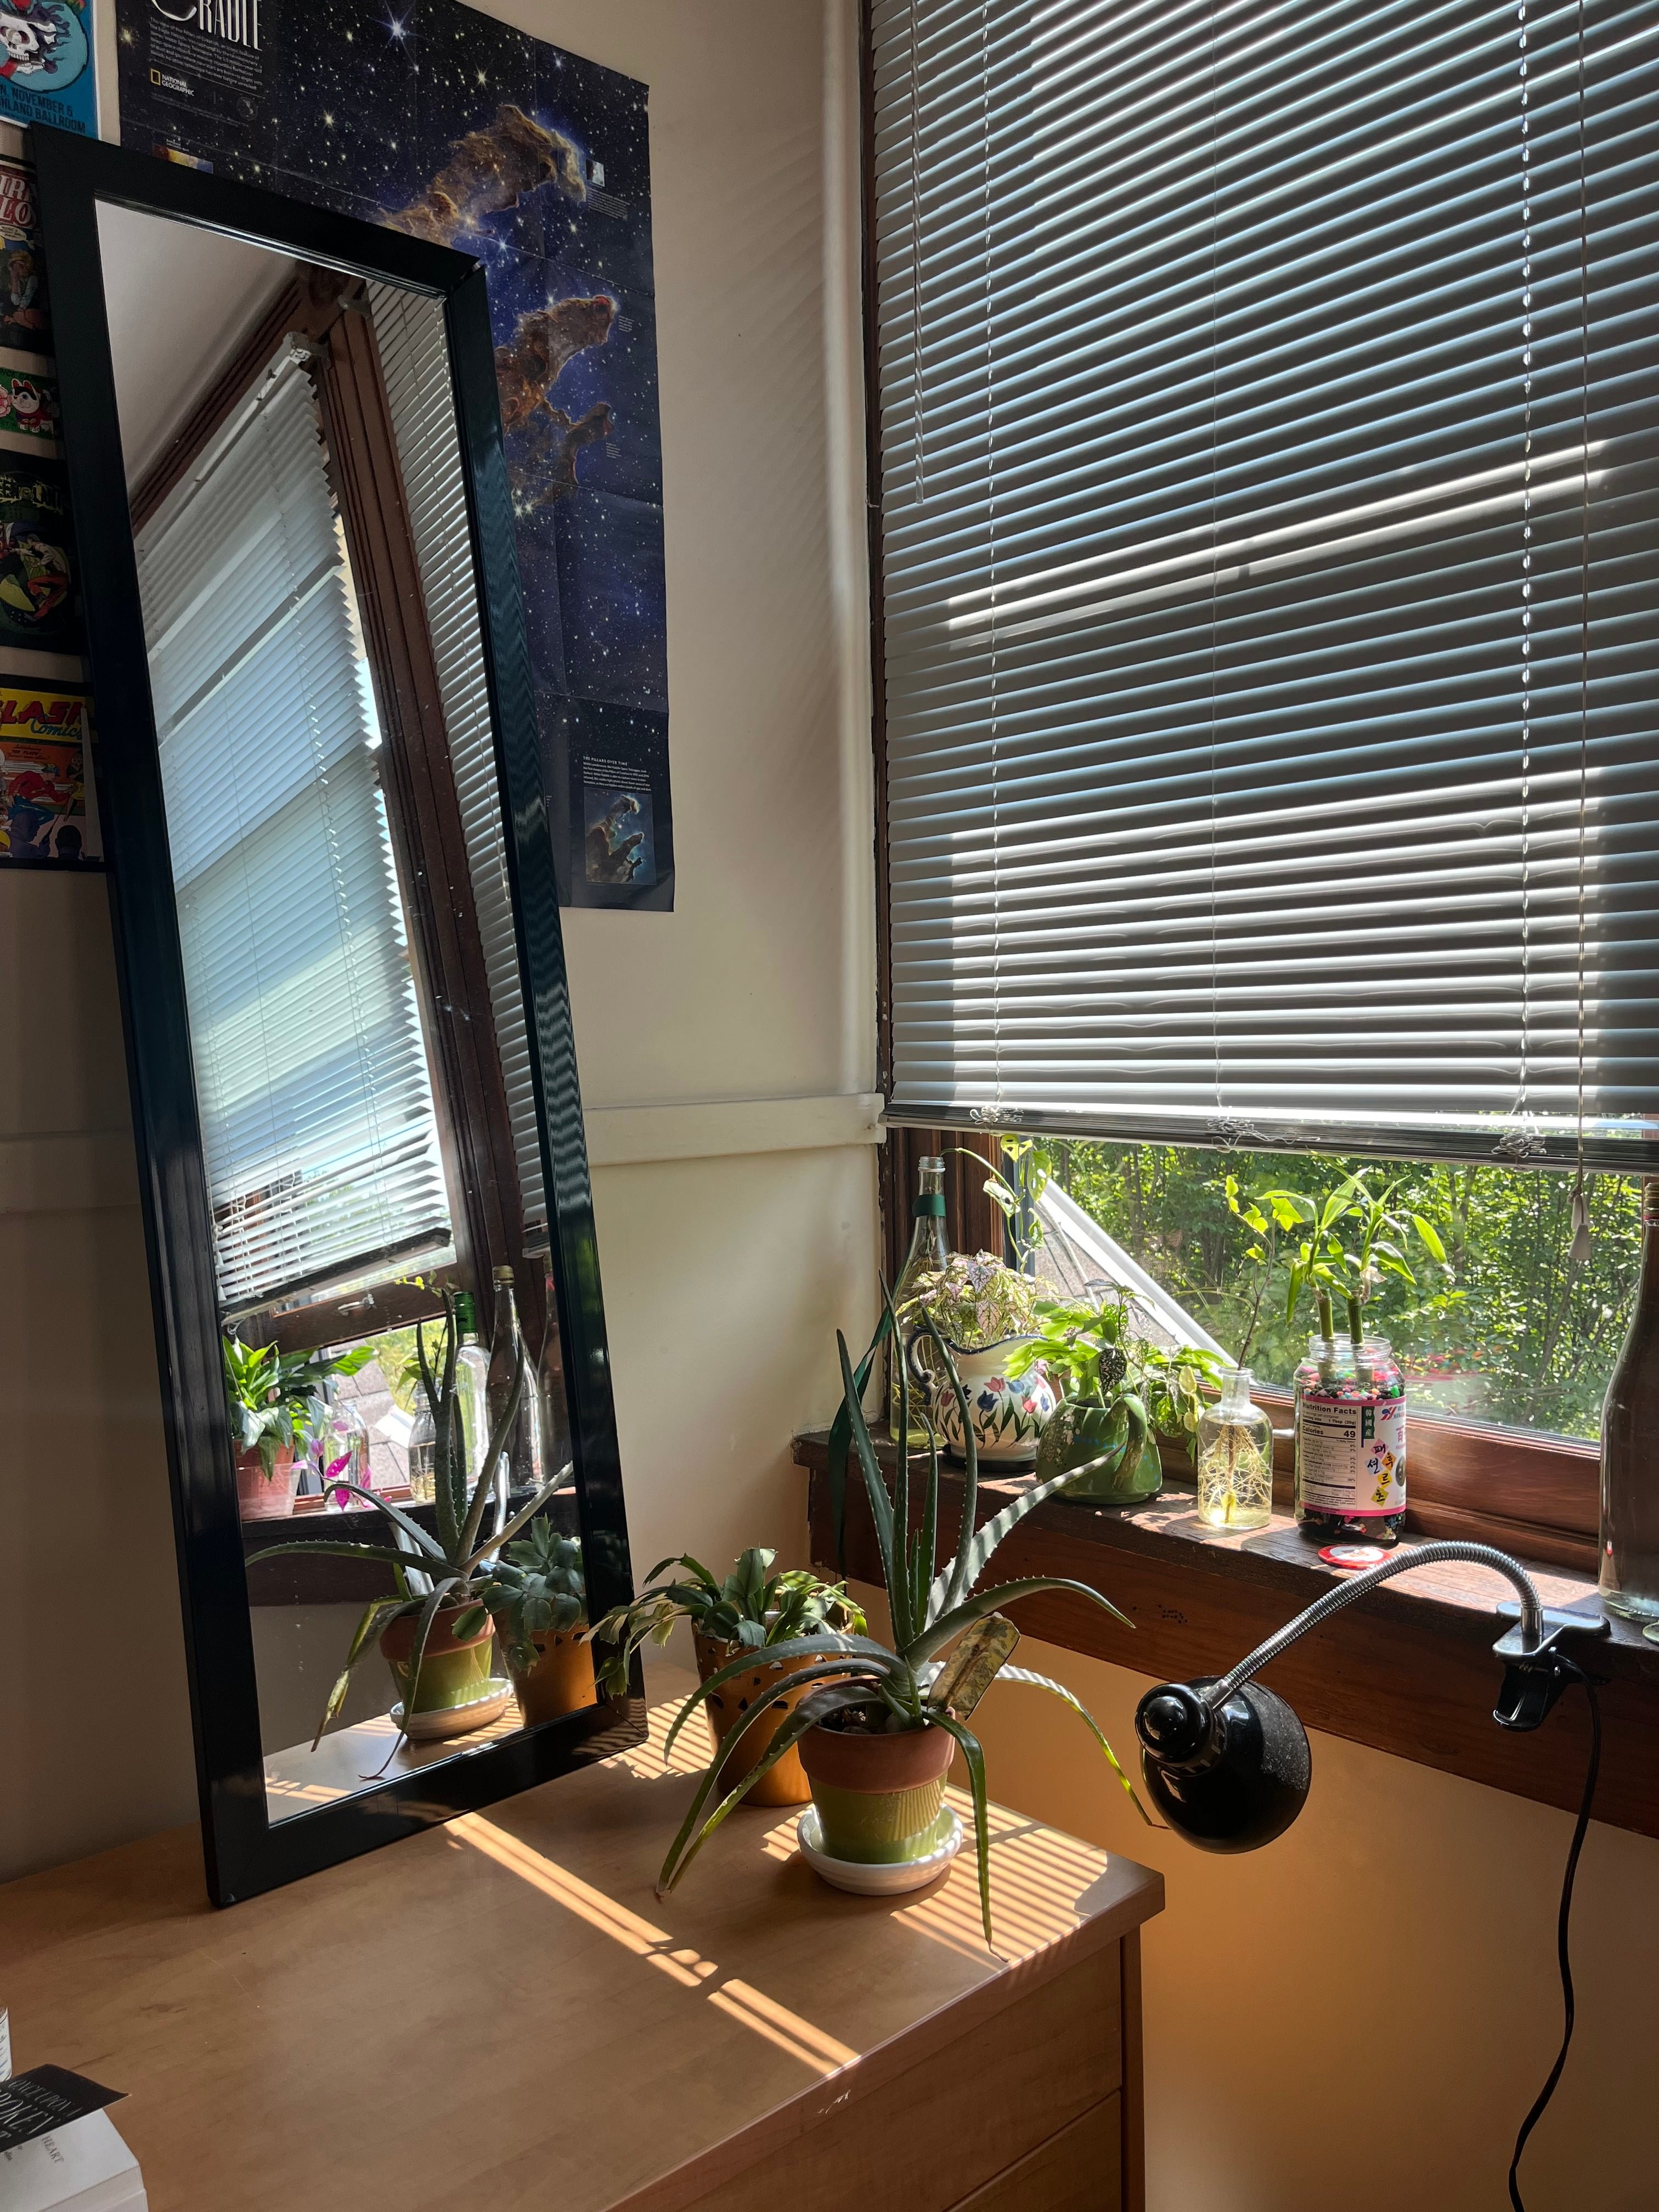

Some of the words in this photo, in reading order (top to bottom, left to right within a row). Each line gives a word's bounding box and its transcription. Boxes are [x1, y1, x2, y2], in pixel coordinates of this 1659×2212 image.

[162, 74, 187, 88] NATIONAL
[162, 81, 195, 97] GEOGRAPHIC
[12, 87, 65, 116] NOVEMBER
[35, 107, 86, 134] BALLROOM
[1302, 1402, 1331, 1413] Nutrition
[1302, 1425, 1324, 1435] Calories
[42, 2134, 65, 2163] HEART
